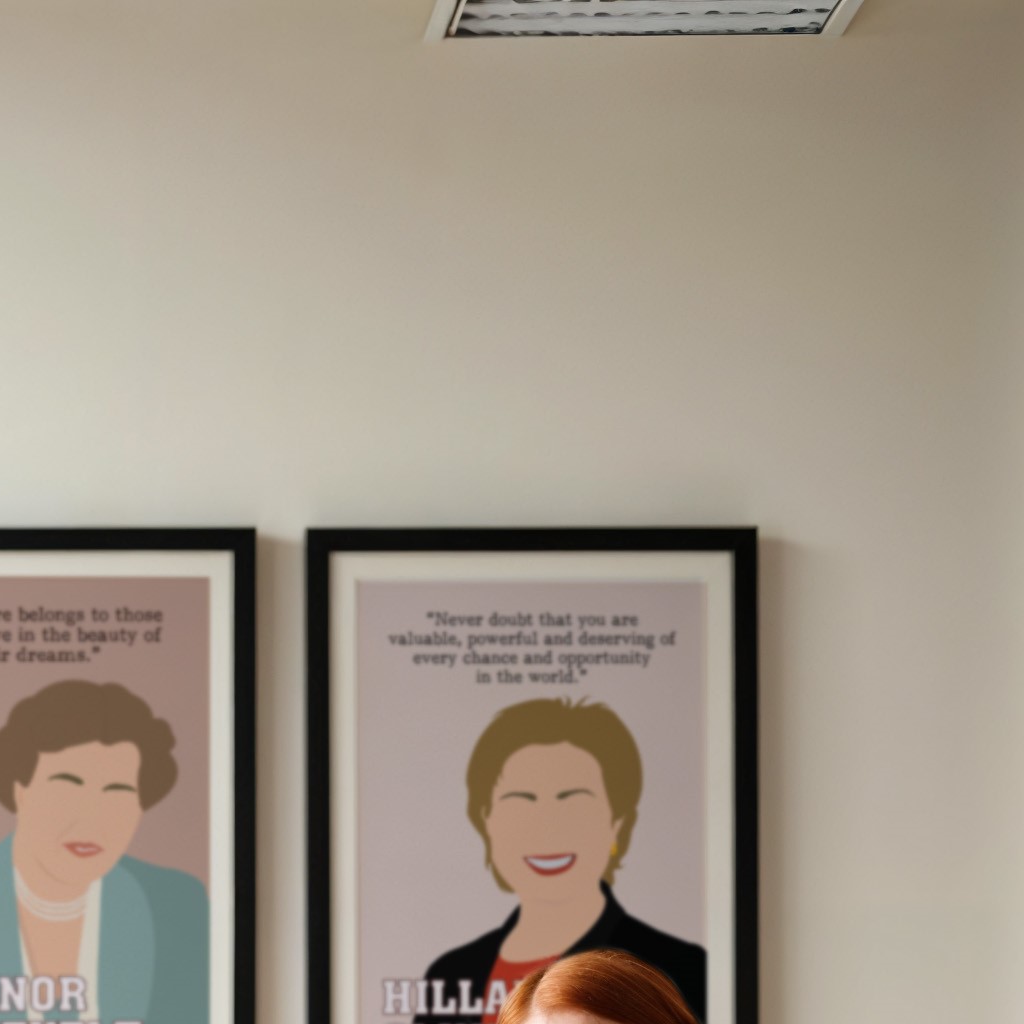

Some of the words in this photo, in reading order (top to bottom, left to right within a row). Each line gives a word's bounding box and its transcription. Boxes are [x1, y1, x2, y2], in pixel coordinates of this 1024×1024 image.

[18, 607, 85, 626] belongs
[91, 608, 109, 622] to
[115, 607, 163, 622] those
[427, 612, 483, 626] "Never
[489, 612, 532, 626] doubt
[539, 612, 572, 626] that
[578, 616, 605, 630] you
[611, 616, 638, 626] are
[19, 627, 35, 642] in
[42, 627, 70, 642] the
[77, 627, 137, 645] beauty
[144, 627, 162, 642] of
[389, 631, 462, 647] valuable,
[468, 631, 537, 648] powerful
[544, 631, 573, 645] and
[579, 631, 654, 649] deserving
[660, 631, 676, 645] of
[16, 646, 100, 662] dreams."
[413, 654, 456, 667] every
[463, 651, 517, 664] chance
[524, 651, 552, 664] and
[558, 651, 651, 668] opportunity
[477, 670, 491, 683] in
[497, 670, 522, 683] the
[528, 669, 587, 684] world."
